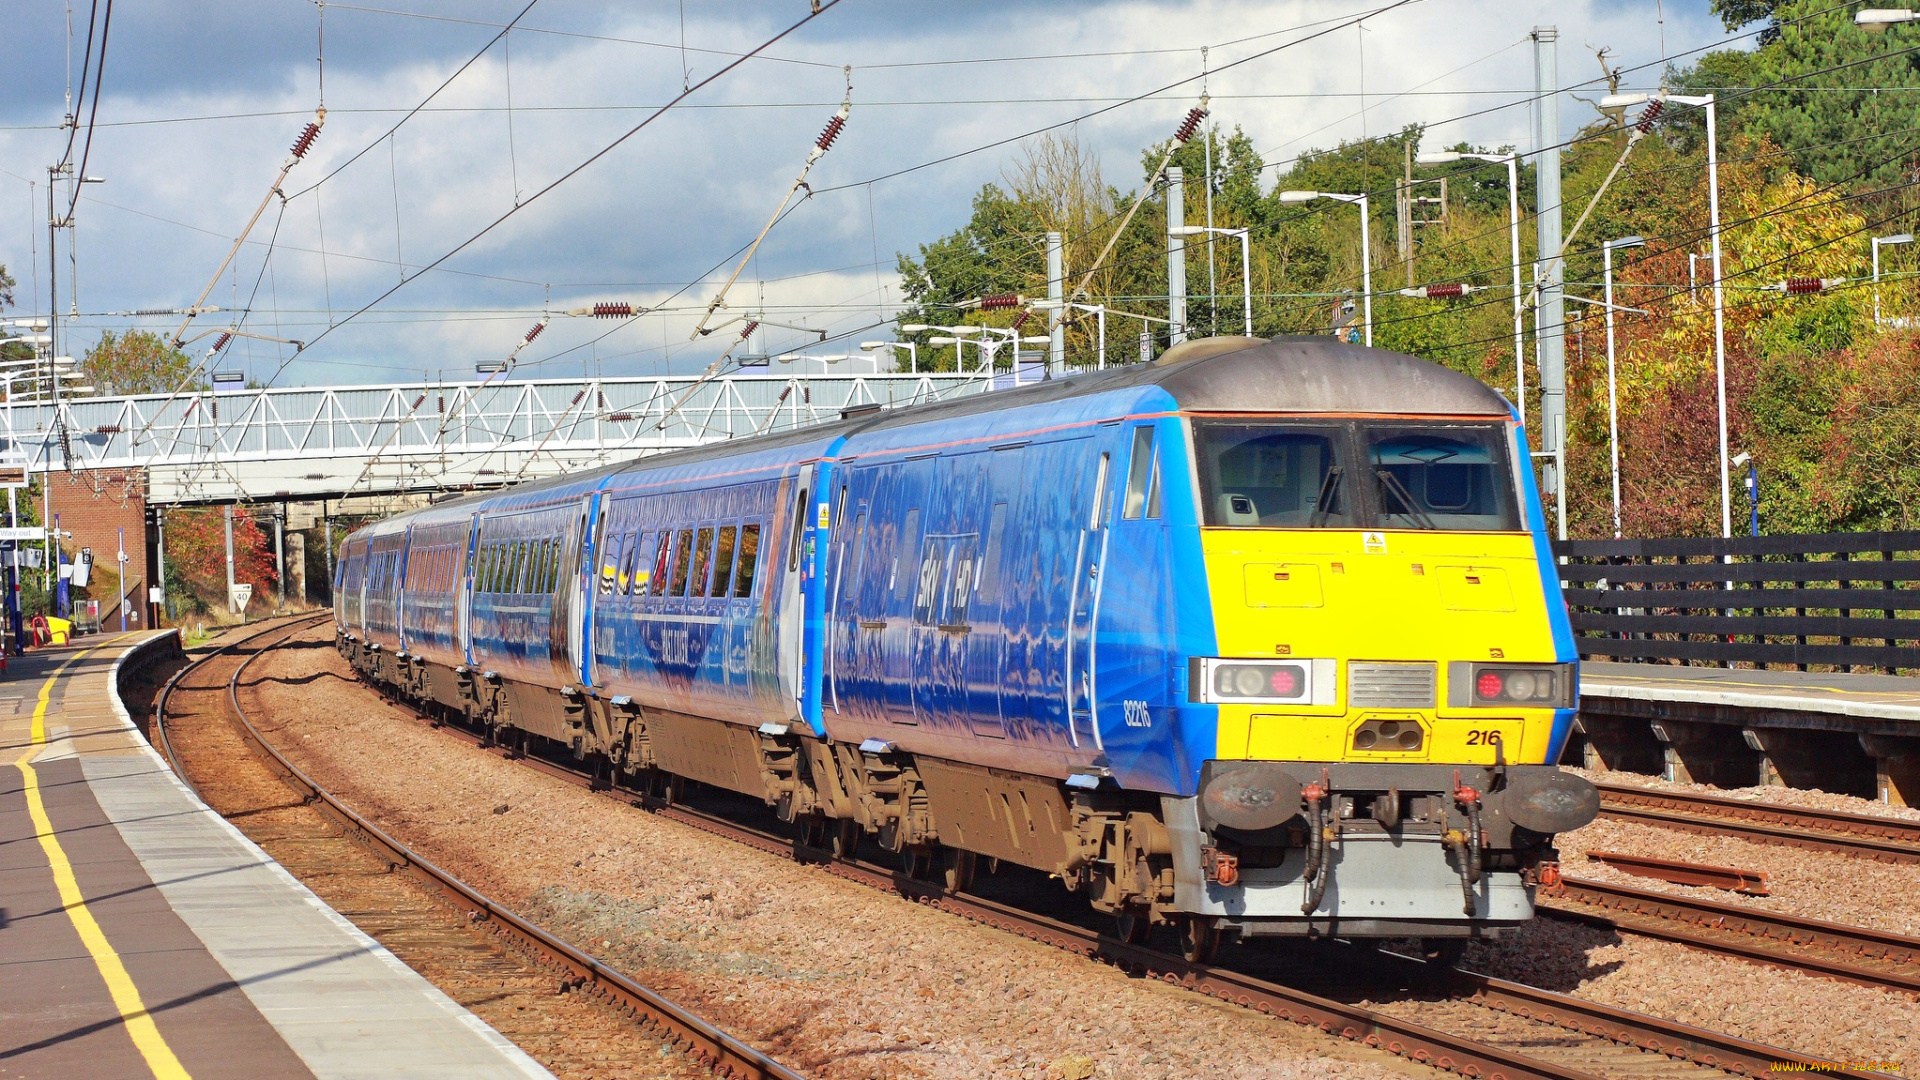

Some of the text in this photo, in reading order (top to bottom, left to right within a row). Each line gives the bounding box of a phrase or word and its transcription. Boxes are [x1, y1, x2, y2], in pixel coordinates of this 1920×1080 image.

[0, 530, 17, 538] Way
[941, 544, 956, 620] 1
[953, 559, 972, 608] HD
[237, 593, 248, 601] 40
[1123, 700, 1152, 727] 82216
[1466, 730, 1501, 746] 216
